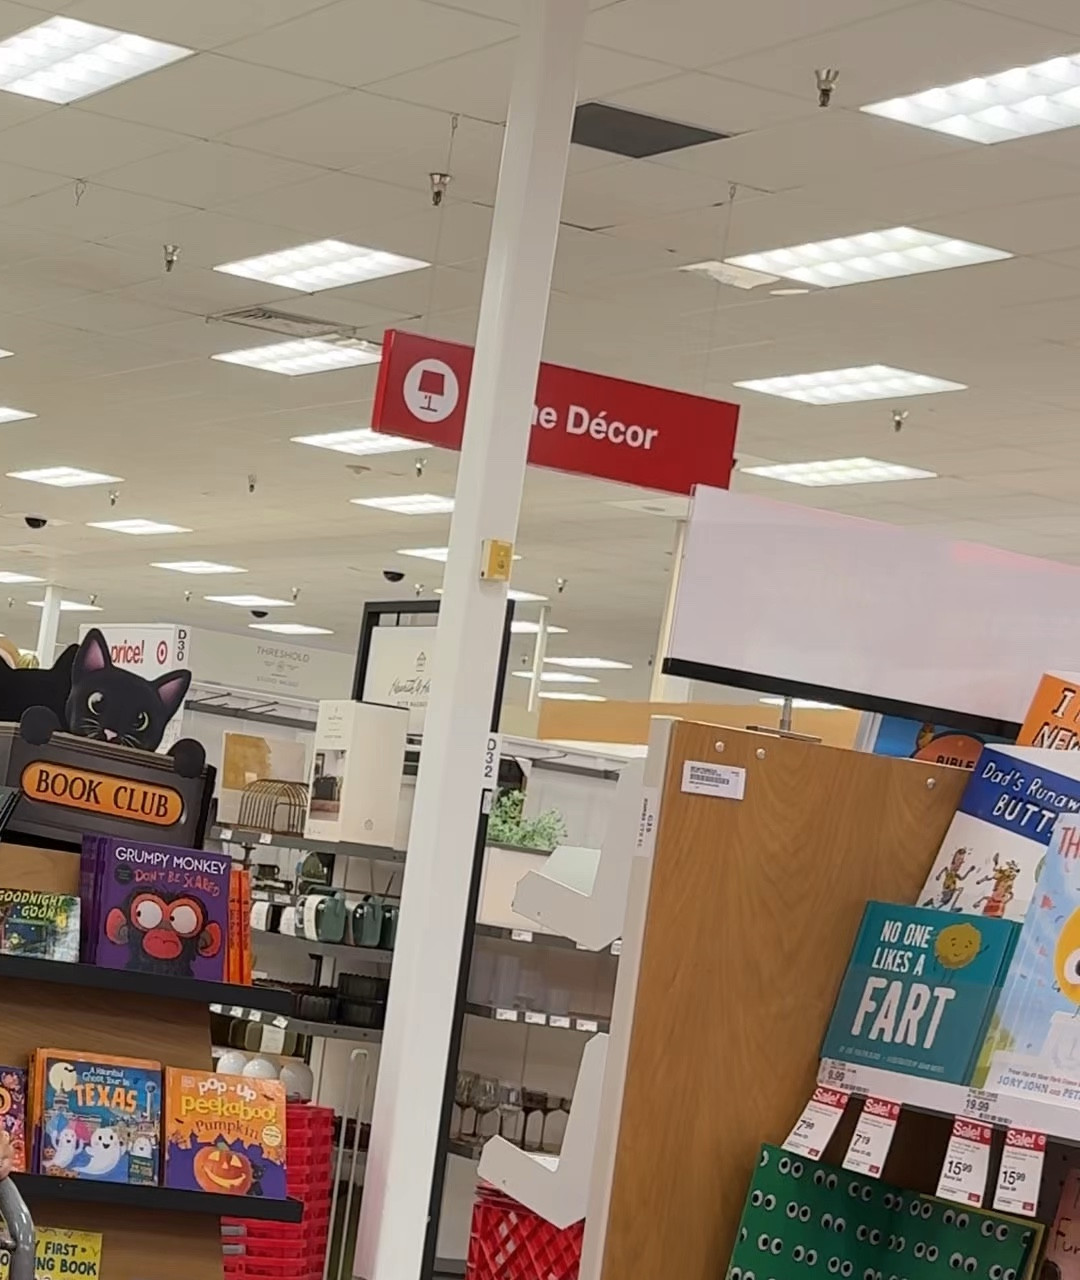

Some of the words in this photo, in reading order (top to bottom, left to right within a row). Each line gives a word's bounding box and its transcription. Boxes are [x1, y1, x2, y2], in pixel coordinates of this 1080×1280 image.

[566, 404, 658, 449] Décor
[110, 639, 145, 665] price!
[176, 628, 187, 662] D30
[256, 646, 310, 662] THRESHOLD
[484, 738, 497, 778] D32
[982, 762, 1025, 792] Dad's
[35, 769, 103, 804] BOOK
[113, 785, 169, 818] CLUB
[993, 794, 1056, 837] BUTT!
[115, 847, 169, 868] GRUMPY
[173, 856, 228, 875] MONKEY
[167, 871, 180, 883] BE
[183, 872, 220, 897] SCARED
[21, 903, 55, 920] GOON
[880, 920, 903, 943] NO
[903, 923, 934, 948] ONE
[872, 947, 912, 973] LIKES
[913, 953, 926, 976] A
[851, 976, 956, 1049] FART
[75, 1083, 138, 1113] TEXAS
[812, 1087, 840, 1105] Sale!
[997, 1075, 1023, 1092] JORY
[1022, 1080, 1049, 1095] JOHN
[181, 1094, 277, 1123] peekaboo!
[863, 1098, 890, 1116] Sale!
[965, 1098, 989, 1112] 19.99
[195, 1119, 259, 1141] Pumpkin
[952, 1121, 981, 1141] Sale!
[1005, 1130, 1035, 1148] Sale!
[44, 1240, 78, 1256] FIRST
[60, 1259, 97, 1276] BOOK
